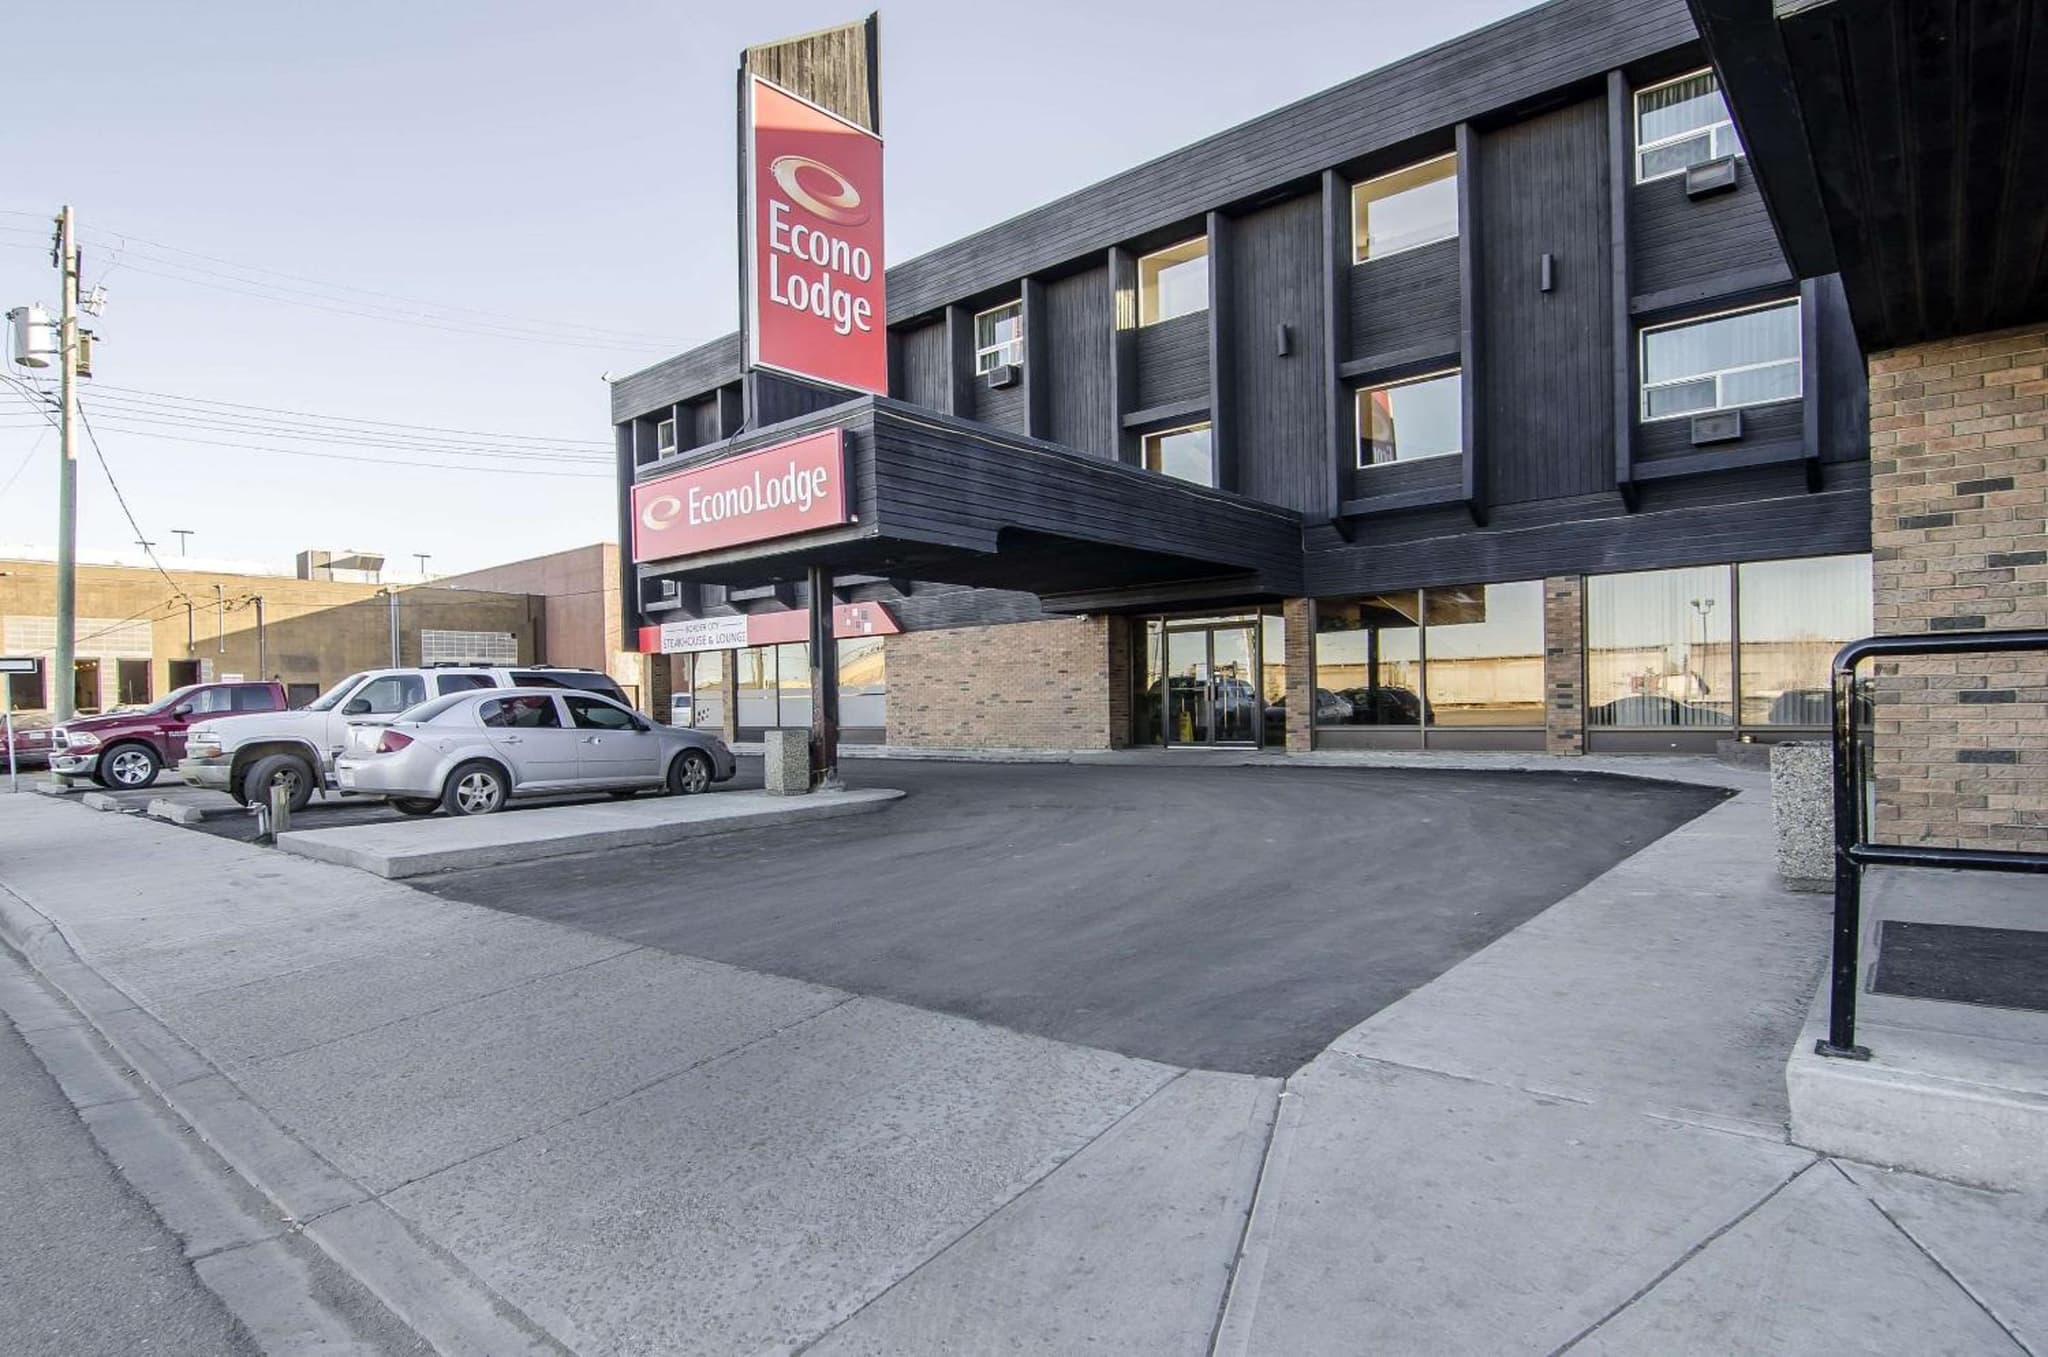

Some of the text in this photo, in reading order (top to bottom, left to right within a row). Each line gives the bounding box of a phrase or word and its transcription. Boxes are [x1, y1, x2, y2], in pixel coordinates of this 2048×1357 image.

[769, 199, 872, 282] Econo
[769, 253, 872, 336] Lodge
[688, 461, 827, 525] EconoLodge
[716, 631, 746, 645] LOUNGE
